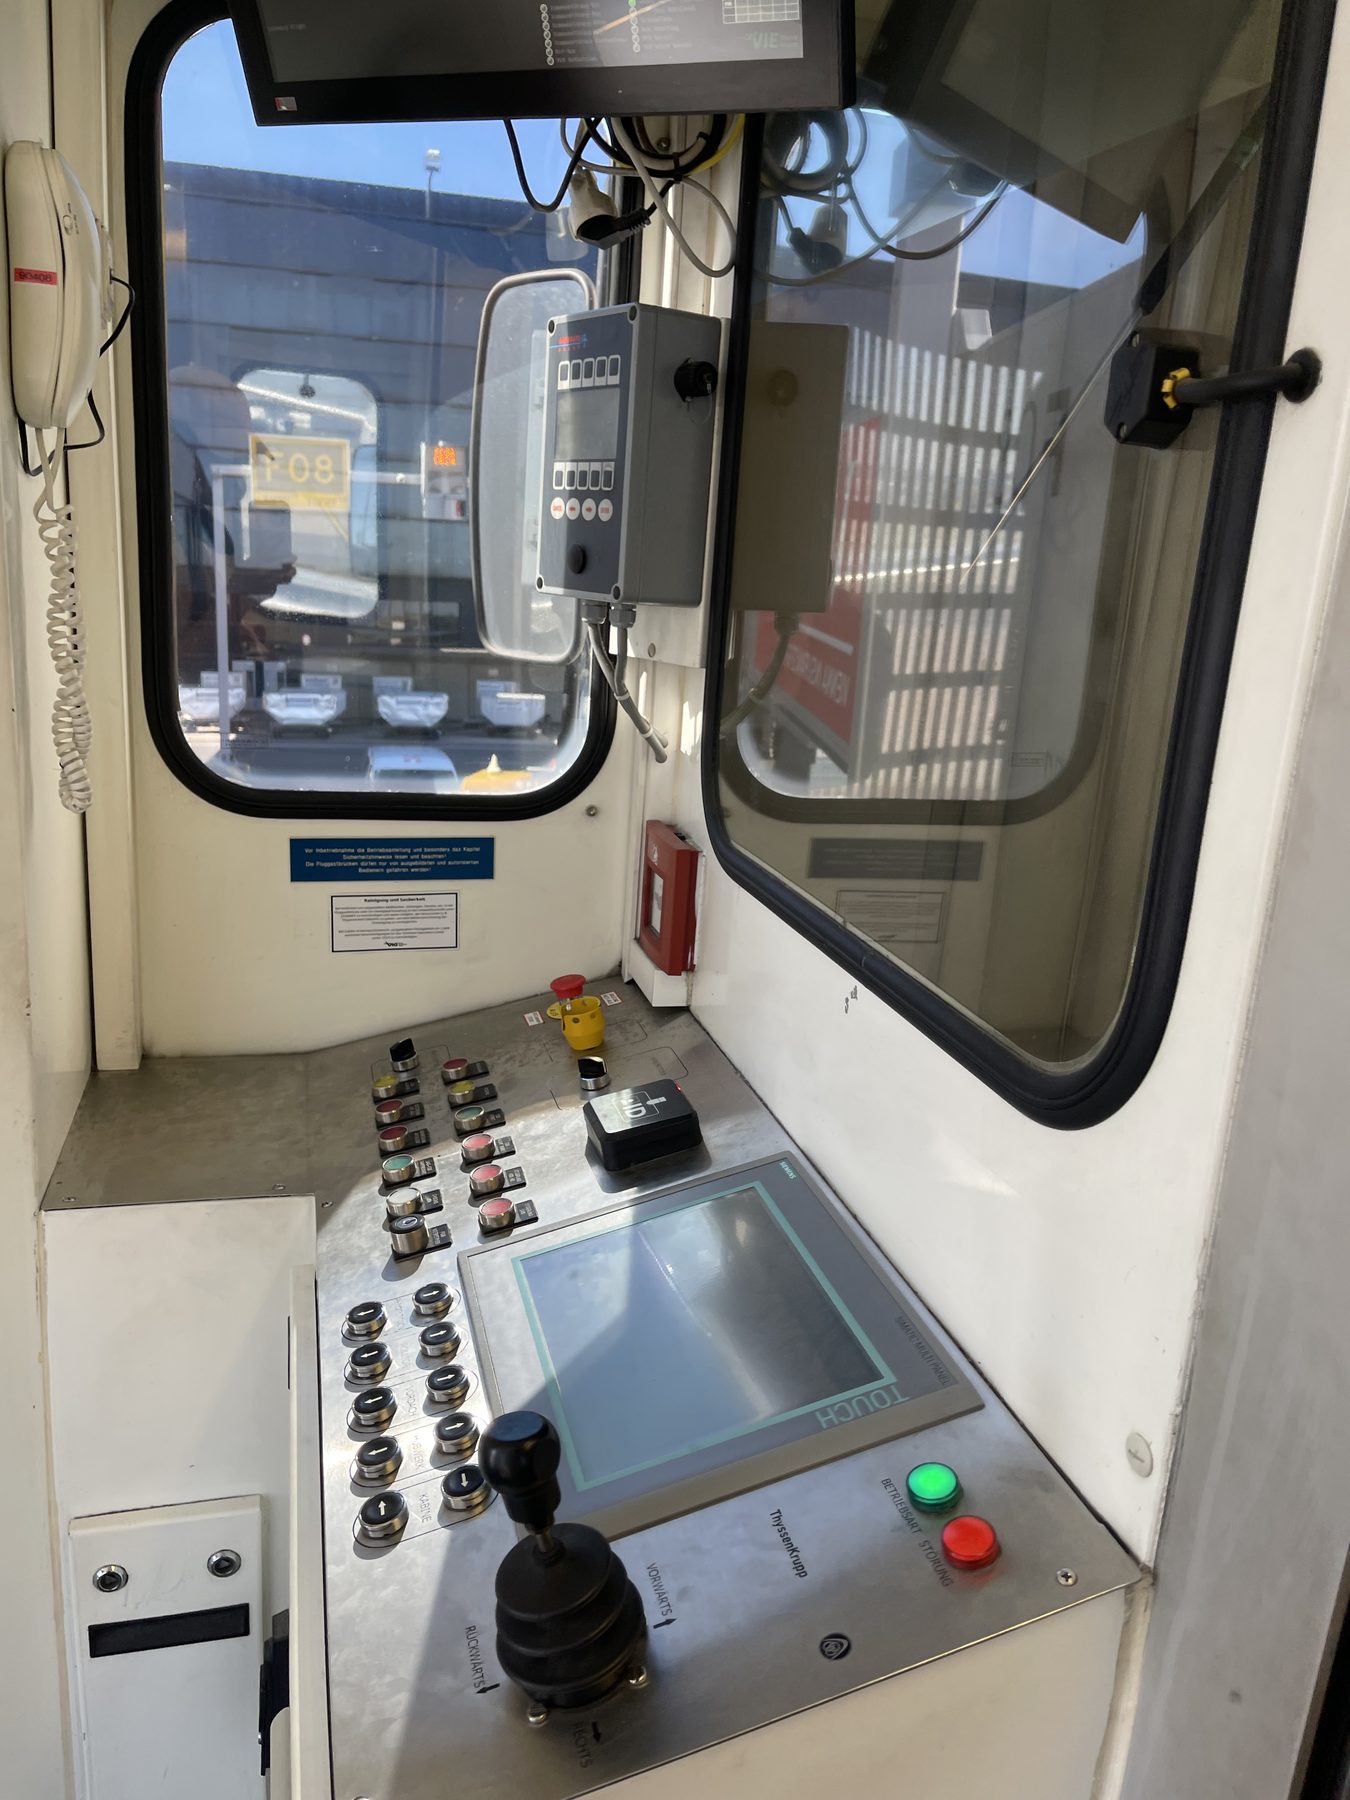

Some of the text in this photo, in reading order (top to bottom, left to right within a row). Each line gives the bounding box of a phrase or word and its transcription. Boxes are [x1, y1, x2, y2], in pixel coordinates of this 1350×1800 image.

[815, 1384, 911, 1430] TOUCH
[419, 1493, 433, 1524] KABINE
[881, 1478, 922, 1534] BETRIEBSART
[769, 1508, 808, 1578] ThyssenKrupp
